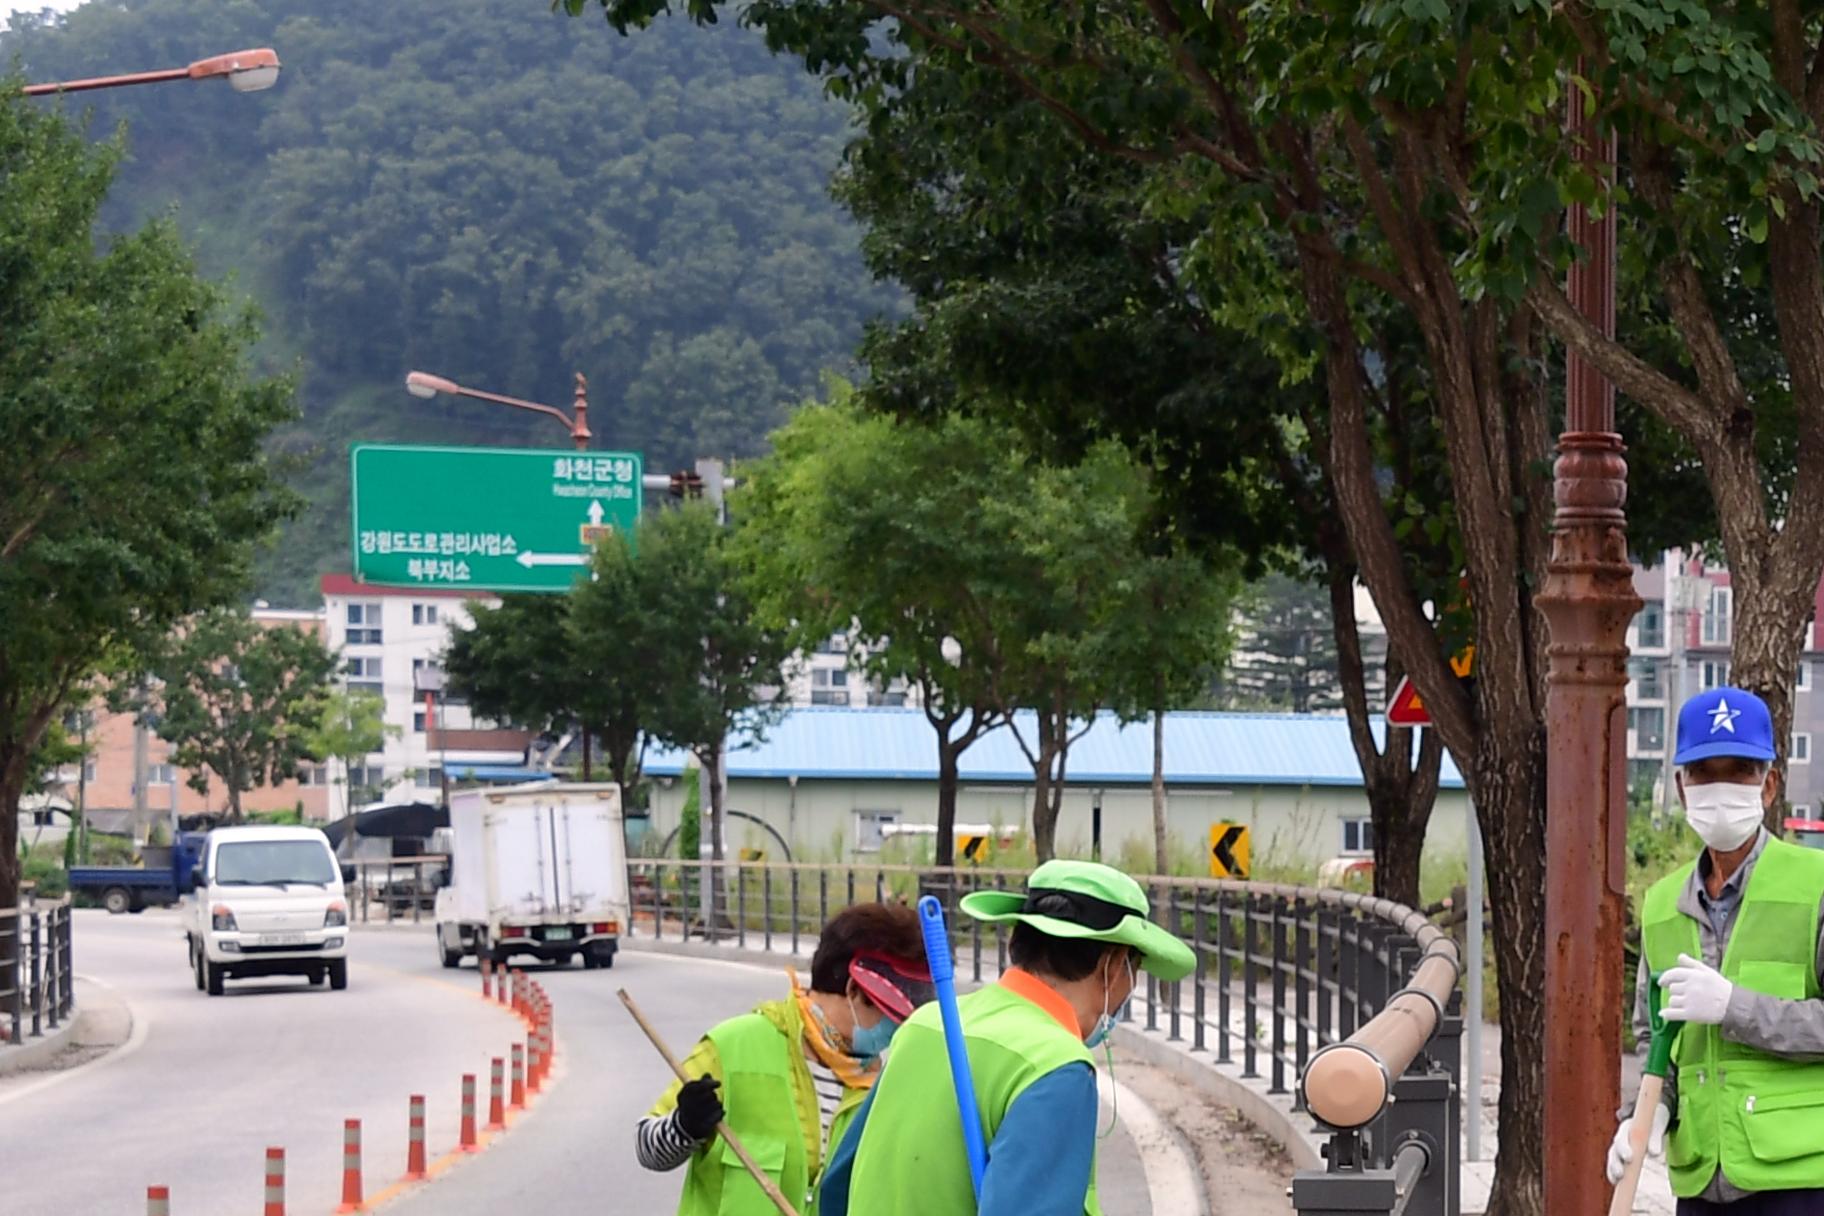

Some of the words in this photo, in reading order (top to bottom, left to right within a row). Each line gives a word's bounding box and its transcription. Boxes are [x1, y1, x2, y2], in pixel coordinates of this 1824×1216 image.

[552, 457, 633, 482] 화천군청
[360, 530, 518, 556] 강원도도로관리사업소
[407, 558, 471, 581] 북부지소
